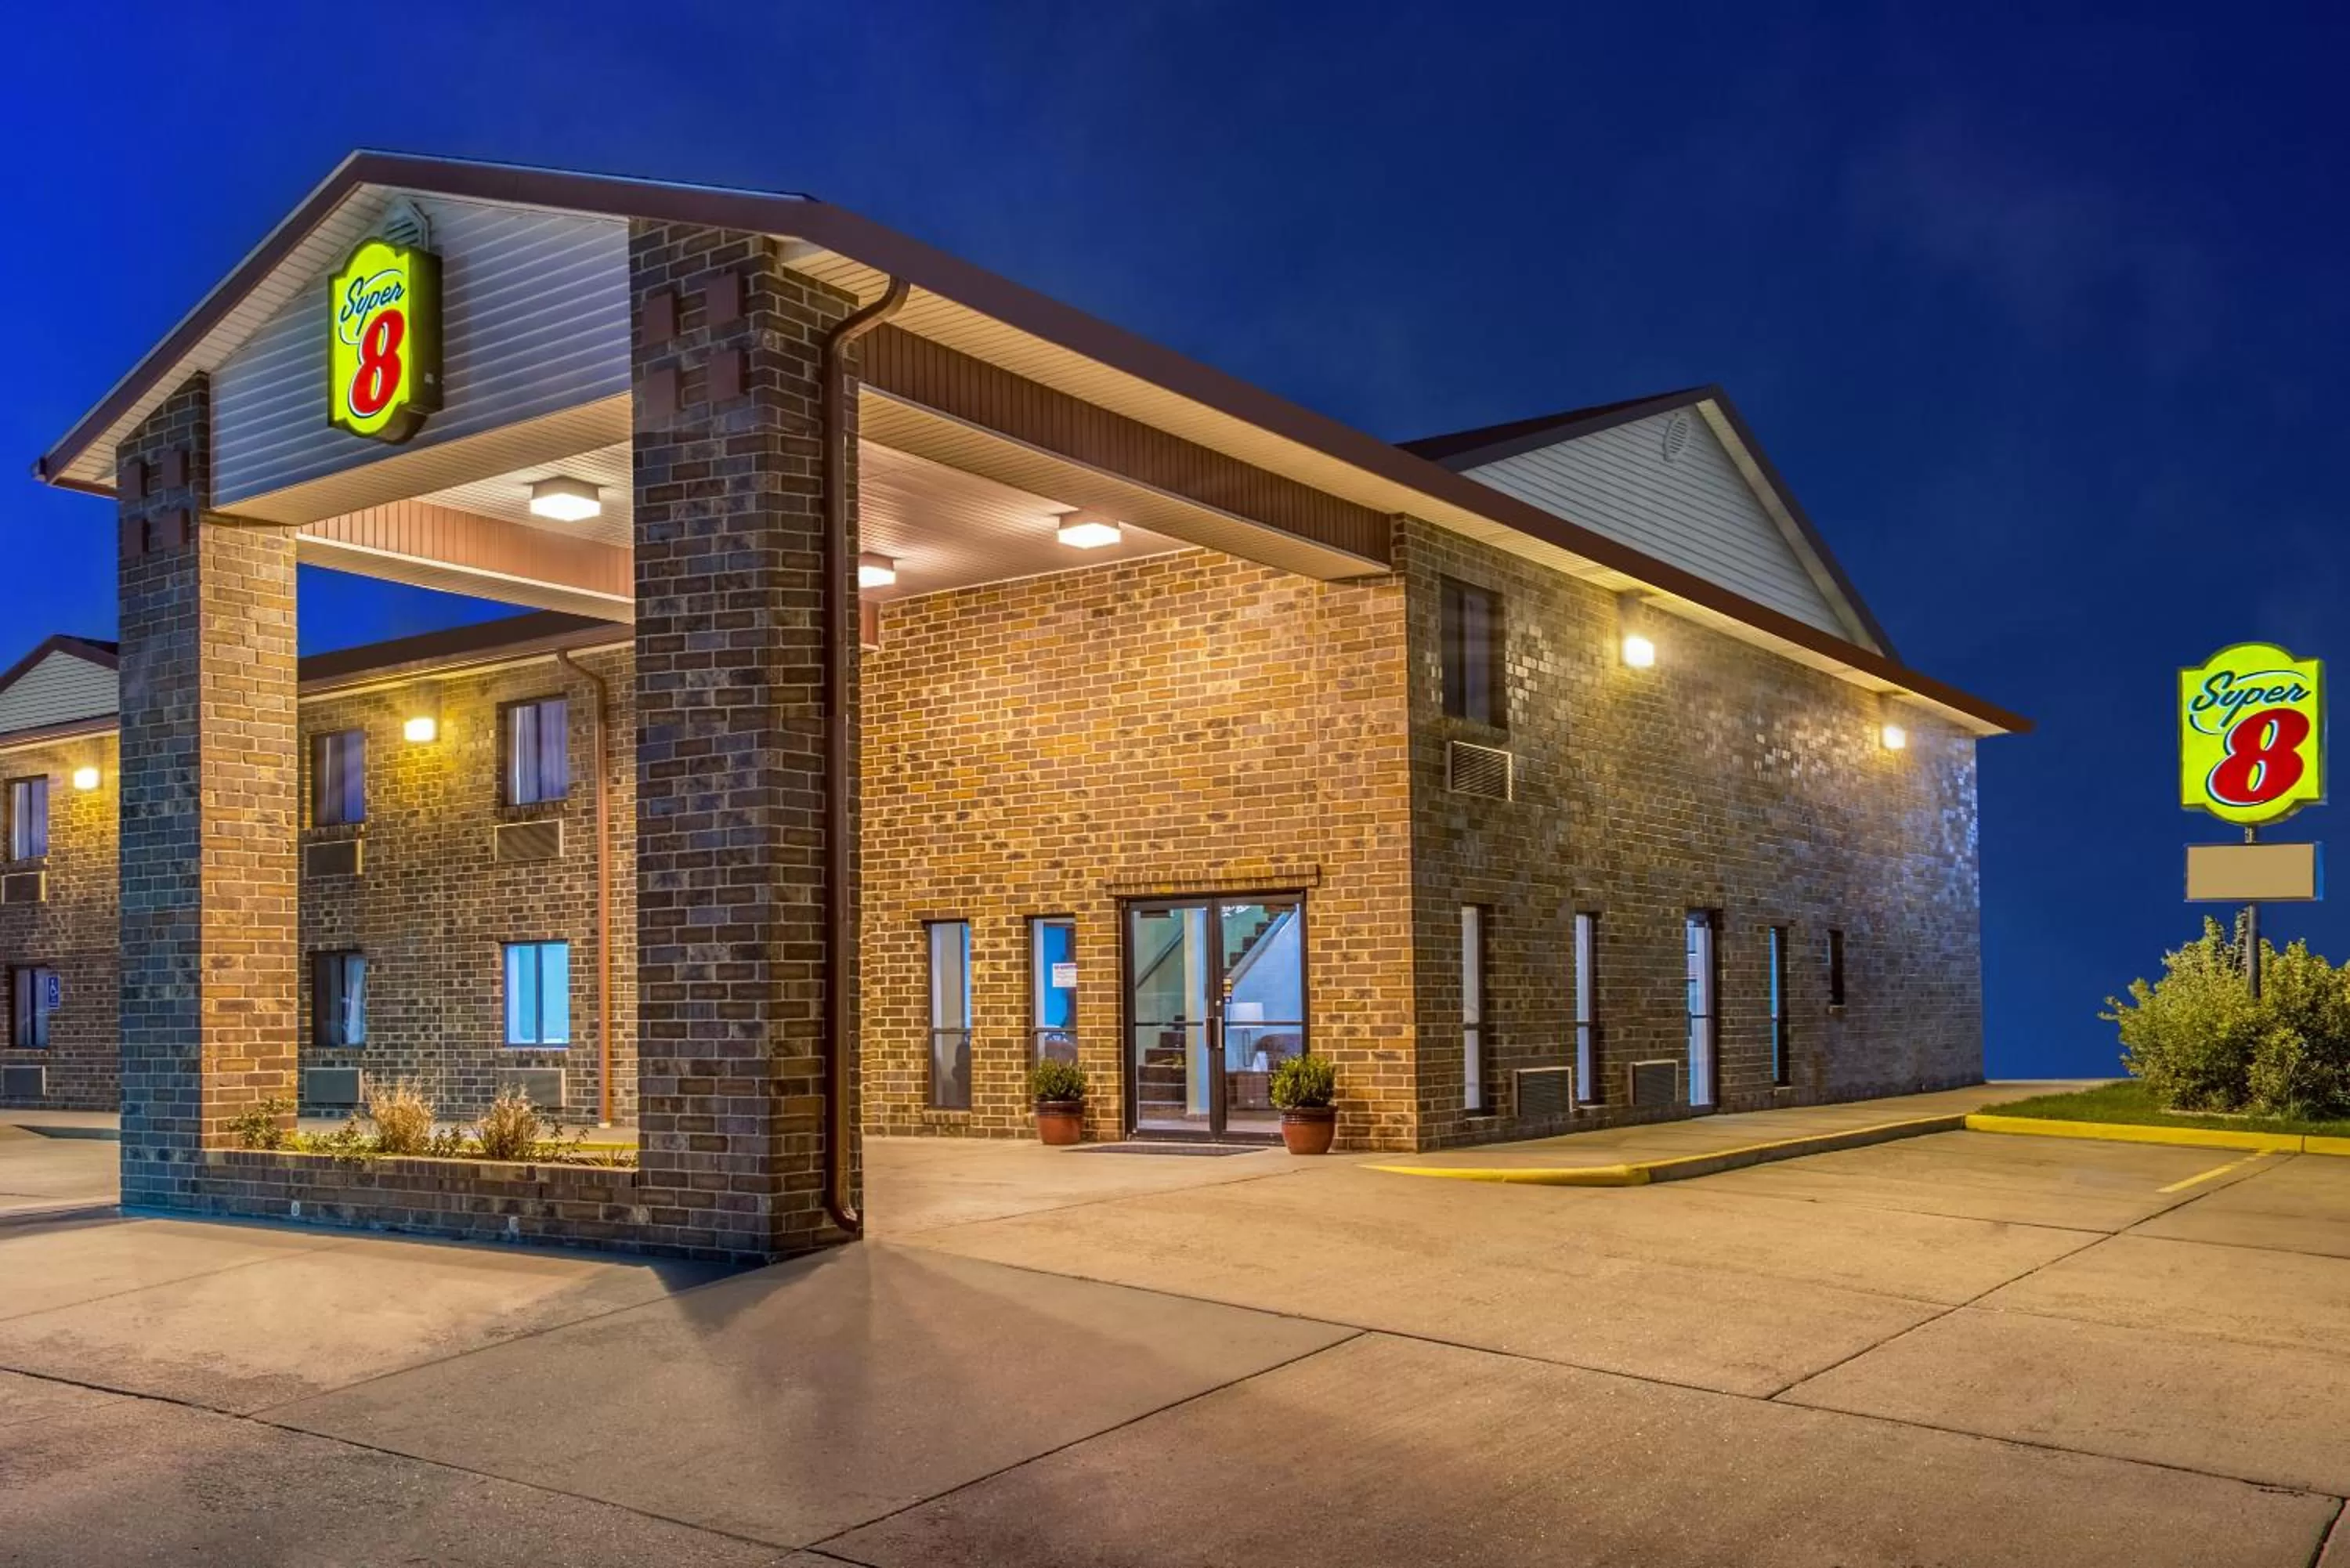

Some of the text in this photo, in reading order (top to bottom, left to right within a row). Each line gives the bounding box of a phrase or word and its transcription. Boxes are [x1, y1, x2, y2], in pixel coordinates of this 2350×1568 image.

[339, 275, 405, 337] Super
[348, 309, 405, 418] 8
[2189, 670, 2311, 729] Super
[2206, 707, 2310, 807] 8
